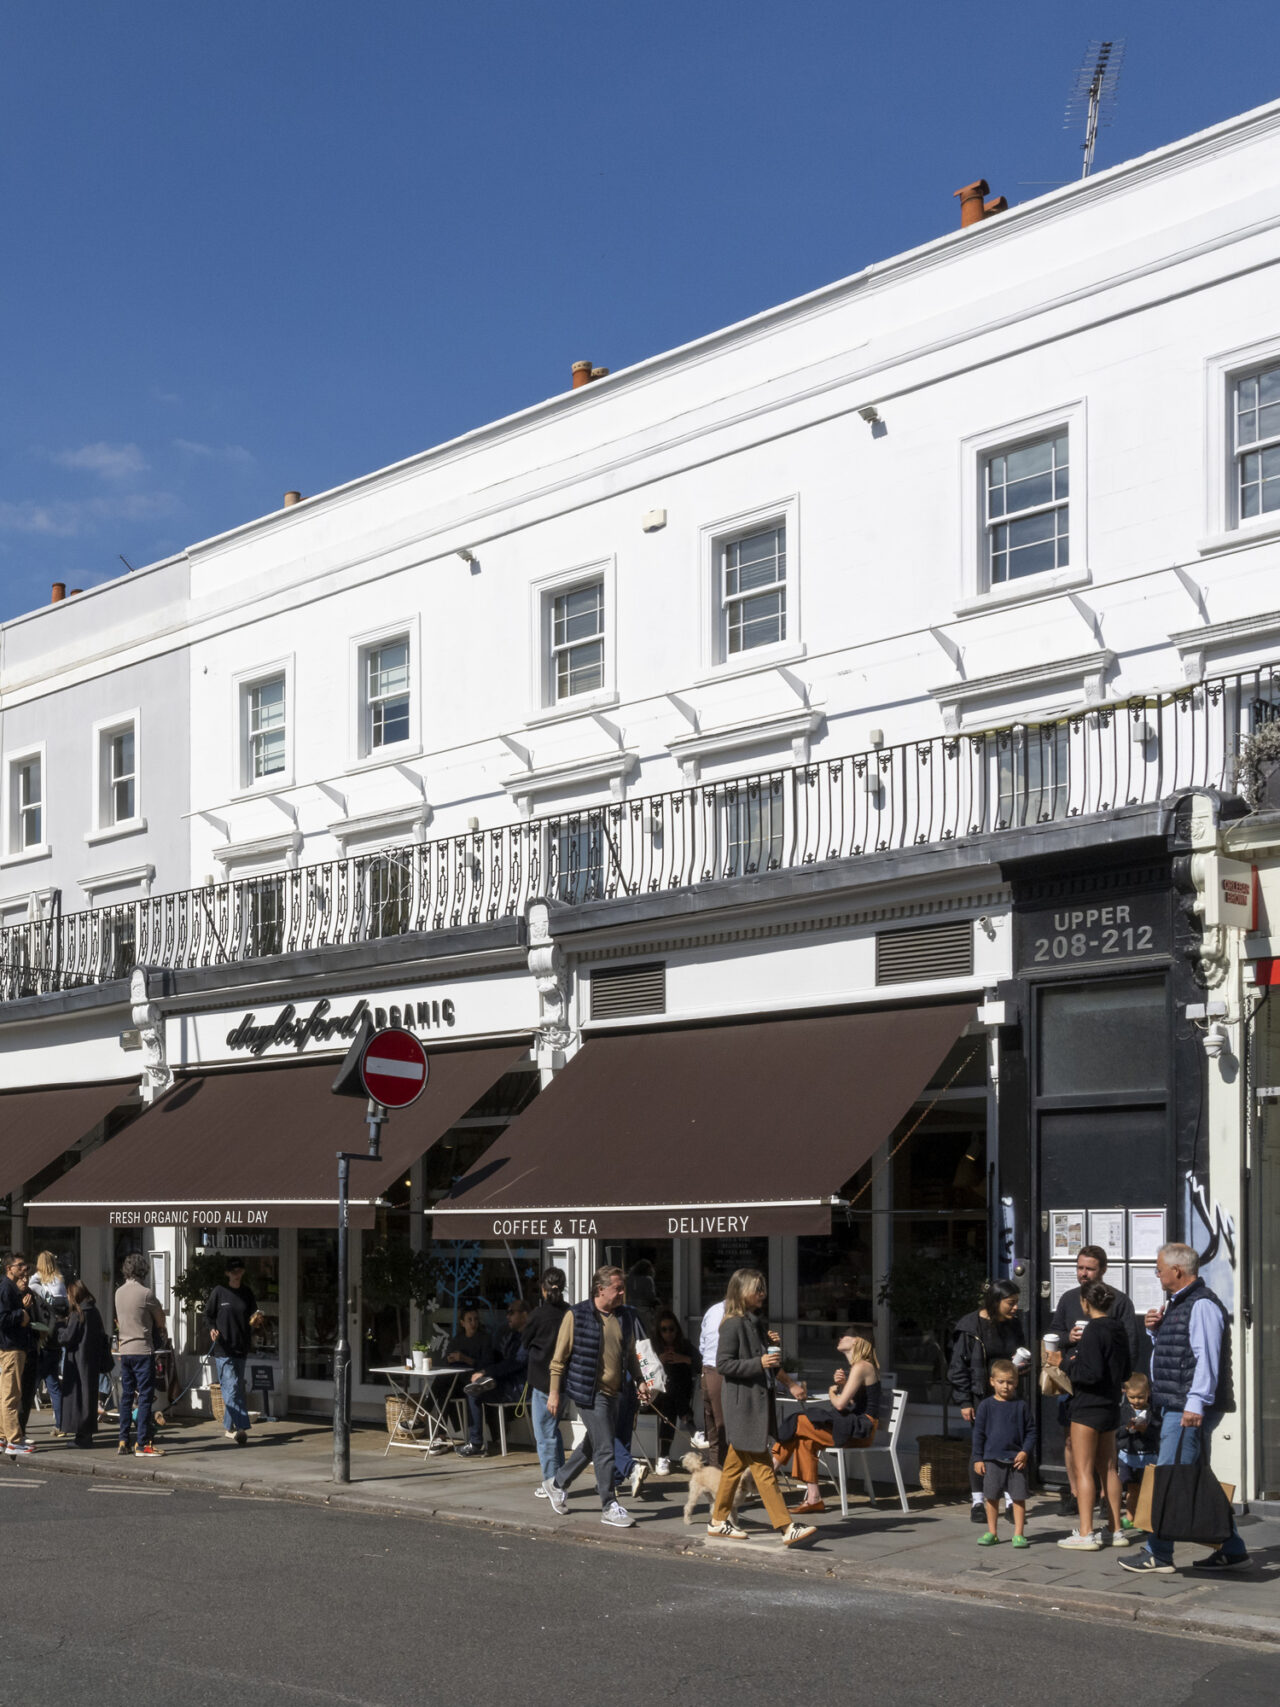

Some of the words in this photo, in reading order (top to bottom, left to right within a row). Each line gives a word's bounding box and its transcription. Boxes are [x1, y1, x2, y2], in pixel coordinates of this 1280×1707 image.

[1054, 905, 1131, 931] UPPER
[1033, 925, 1153, 962] 208-212
[109, 1211, 141, 1224] FRESH
[143, 1211, 189, 1224] ORGANIC
[192, 1210, 221, 1224] FOOD
[224, 1210, 243, 1224] ALL
[247, 1210, 269, 1224] DAY
[493, 1219, 548, 1235] COFFEE
[553, 1219, 563, 1234] &
[569, 1219, 598, 1235] TEA
[668, 1215, 749, 1234] DELIVERY
